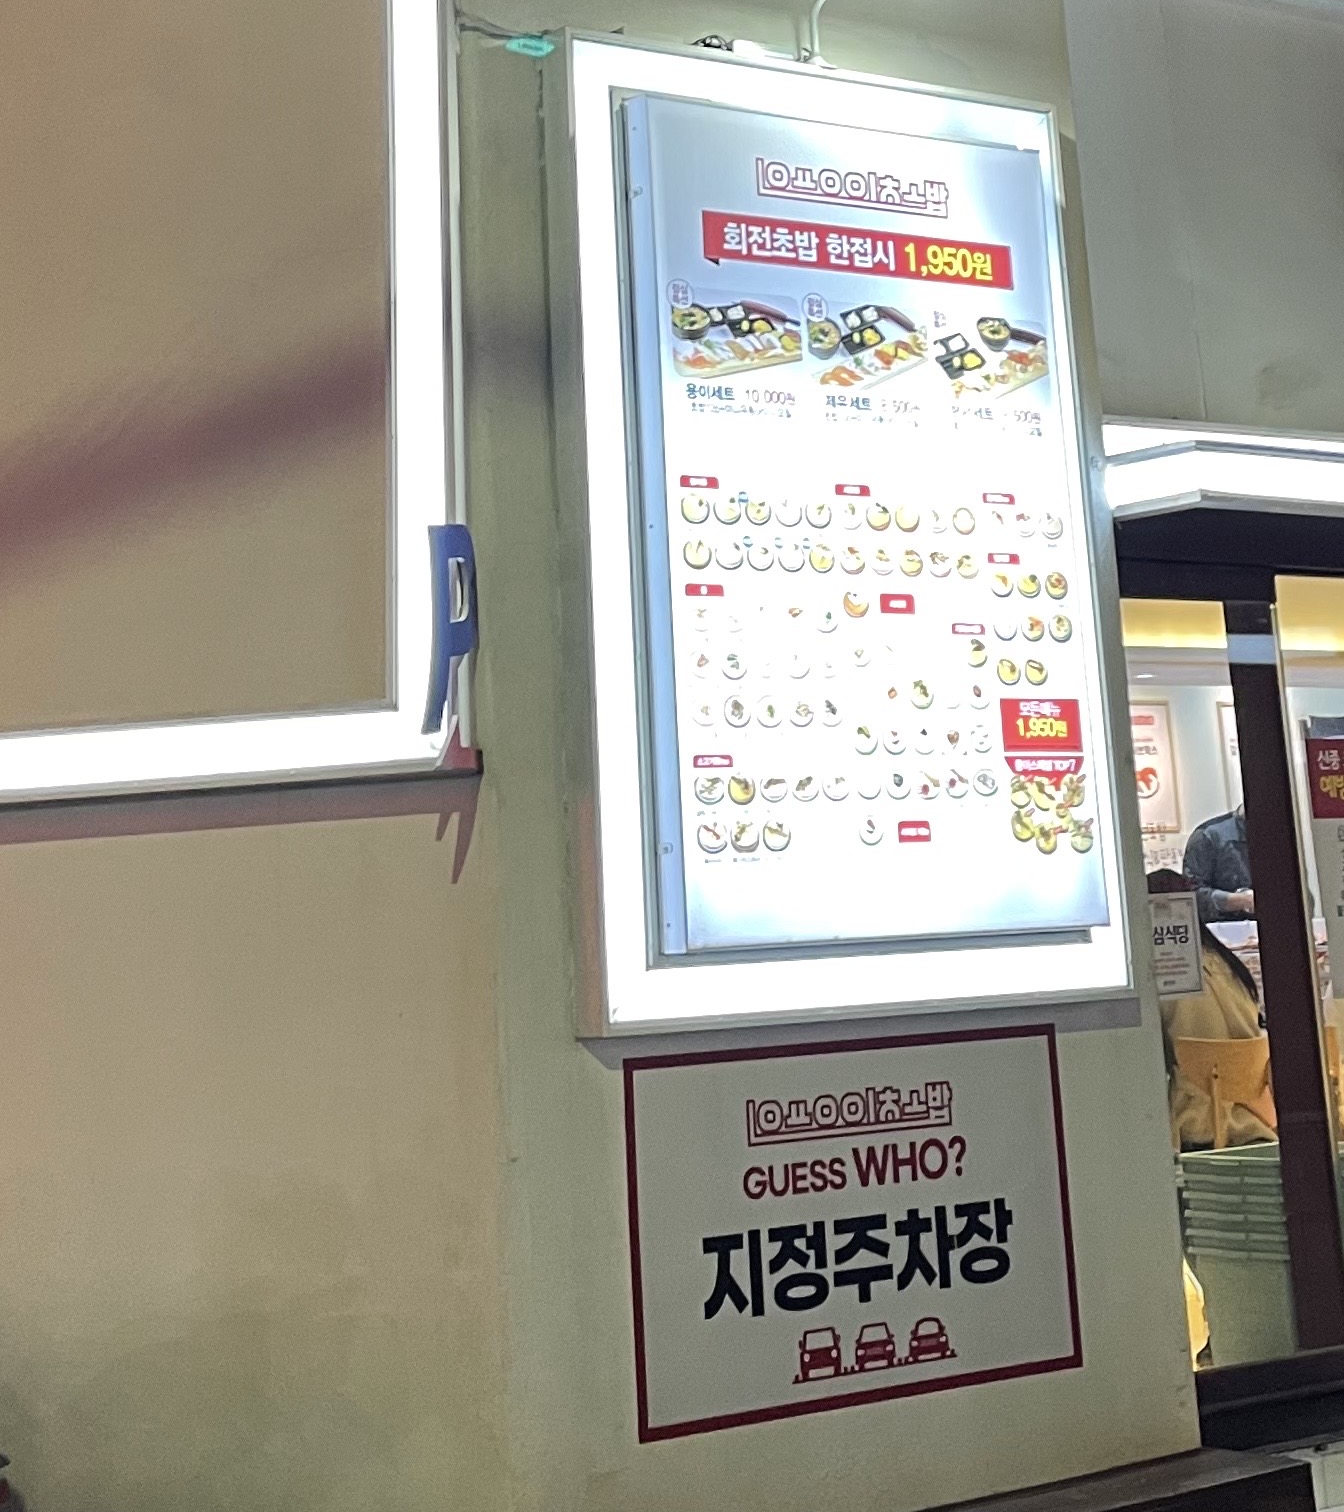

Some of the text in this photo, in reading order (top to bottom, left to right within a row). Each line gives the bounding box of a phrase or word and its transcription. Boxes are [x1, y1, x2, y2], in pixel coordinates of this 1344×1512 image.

[723, 222, 994, 281] 회전초밥 한접시 1,950원
[743, 1135, 967, 1199] GUESS WHO?
[702, 1197, 1013, 1319] 지정주차장
